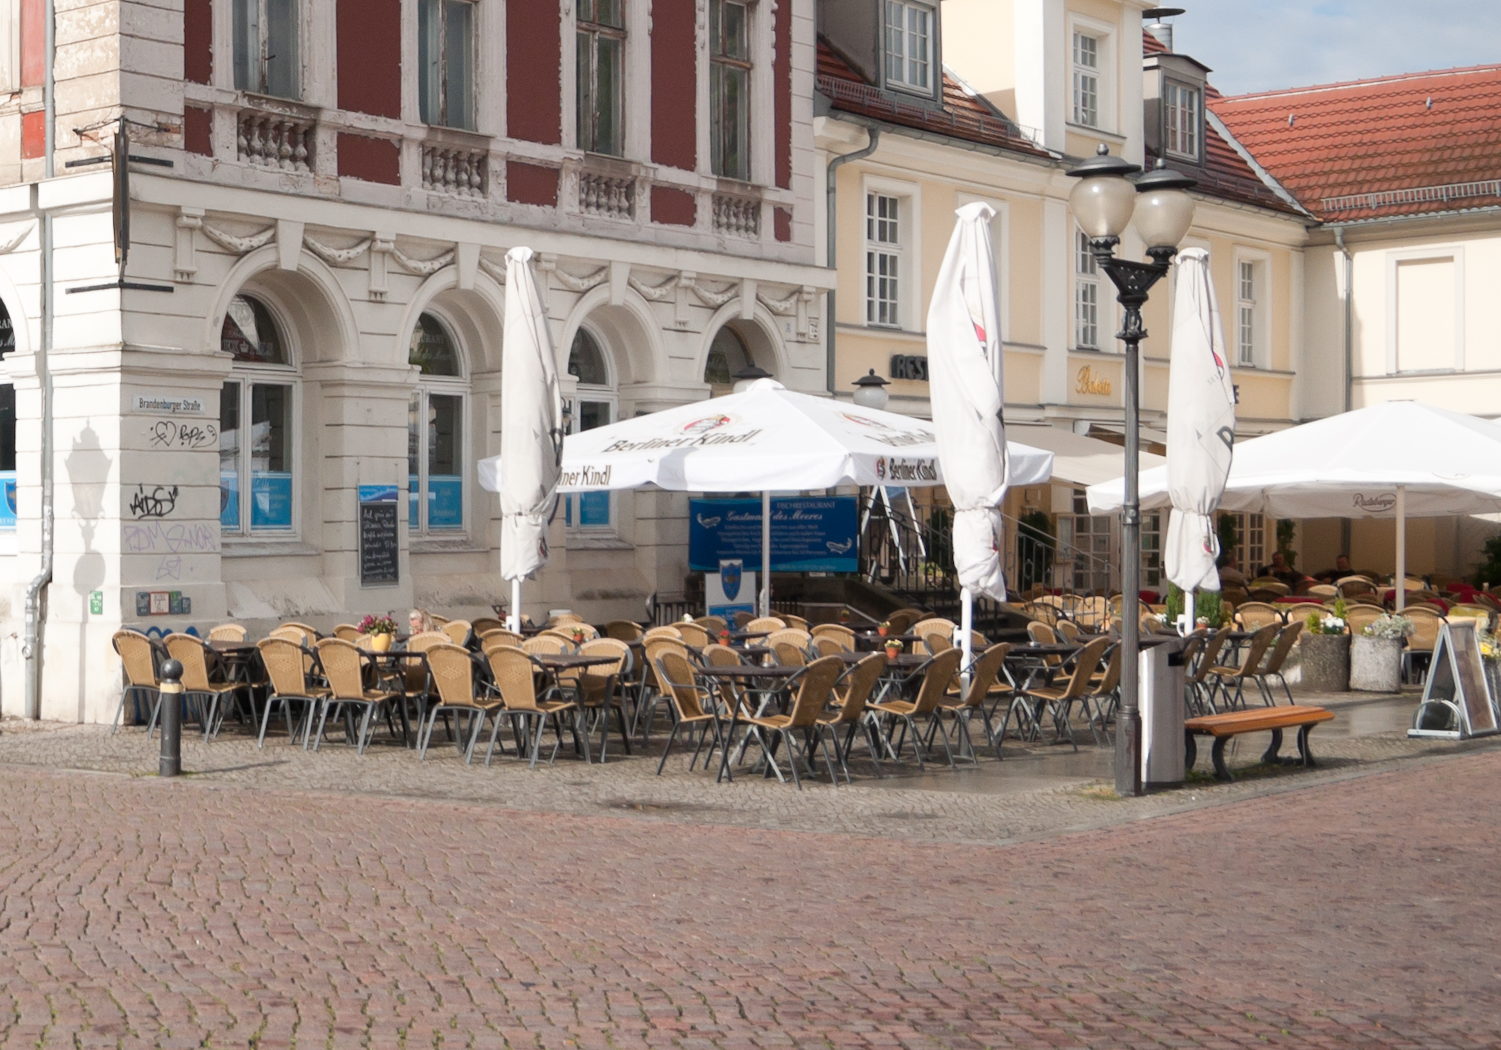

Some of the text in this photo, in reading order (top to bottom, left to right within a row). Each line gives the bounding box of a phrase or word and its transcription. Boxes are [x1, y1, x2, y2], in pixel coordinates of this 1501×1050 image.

[139, 397, 201, 413] Brandenburger Straße
[602, 428, 764, 453] Berliner Kindl
[581, 465, 612, 486] Kindl
[889, 457, 938, 481] Berliner Kindl
[776, 501, 836, 509] FISCHRESTAURANT
[726, 510, 773, 521] Gastma
